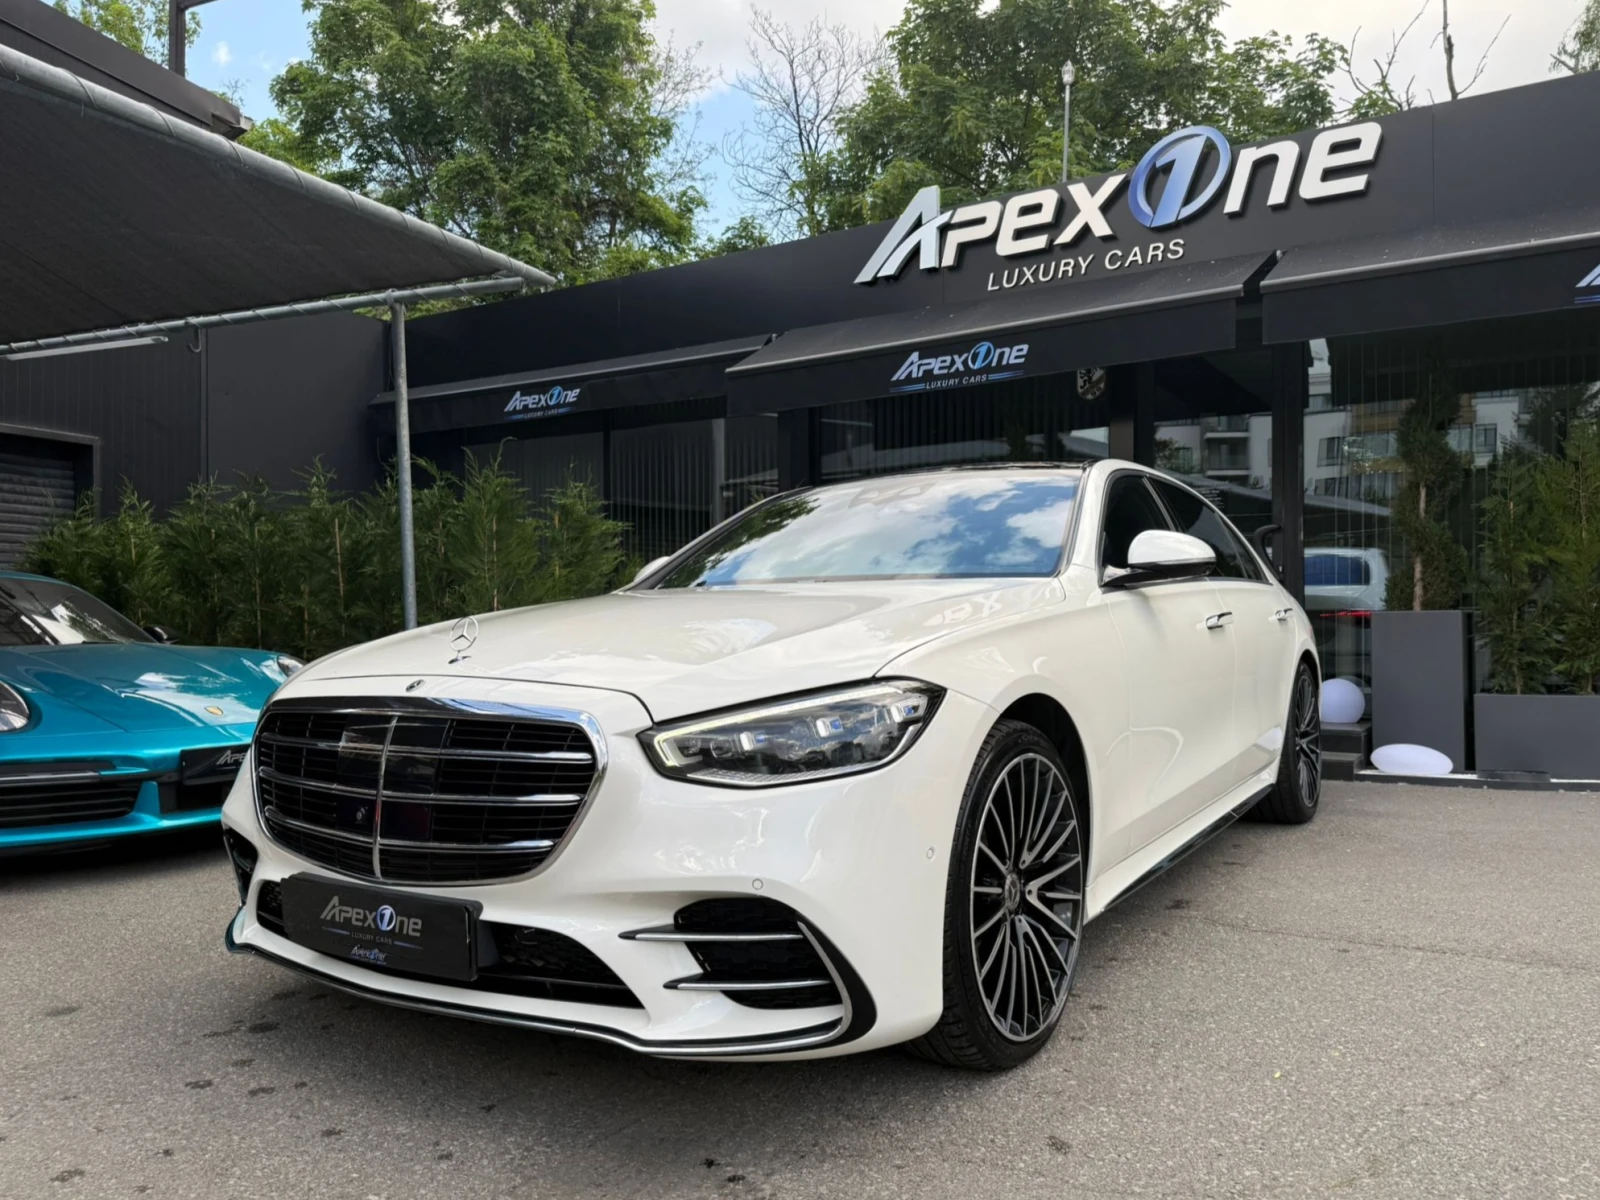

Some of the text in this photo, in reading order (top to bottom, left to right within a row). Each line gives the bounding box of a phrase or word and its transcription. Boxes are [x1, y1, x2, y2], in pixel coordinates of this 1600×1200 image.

[987, 239, 1187, 291] LUXURY CARS
[926, 374, 987, 389] LUXURY CARS
[351, 931, 393, 945] LUXURY CARS
